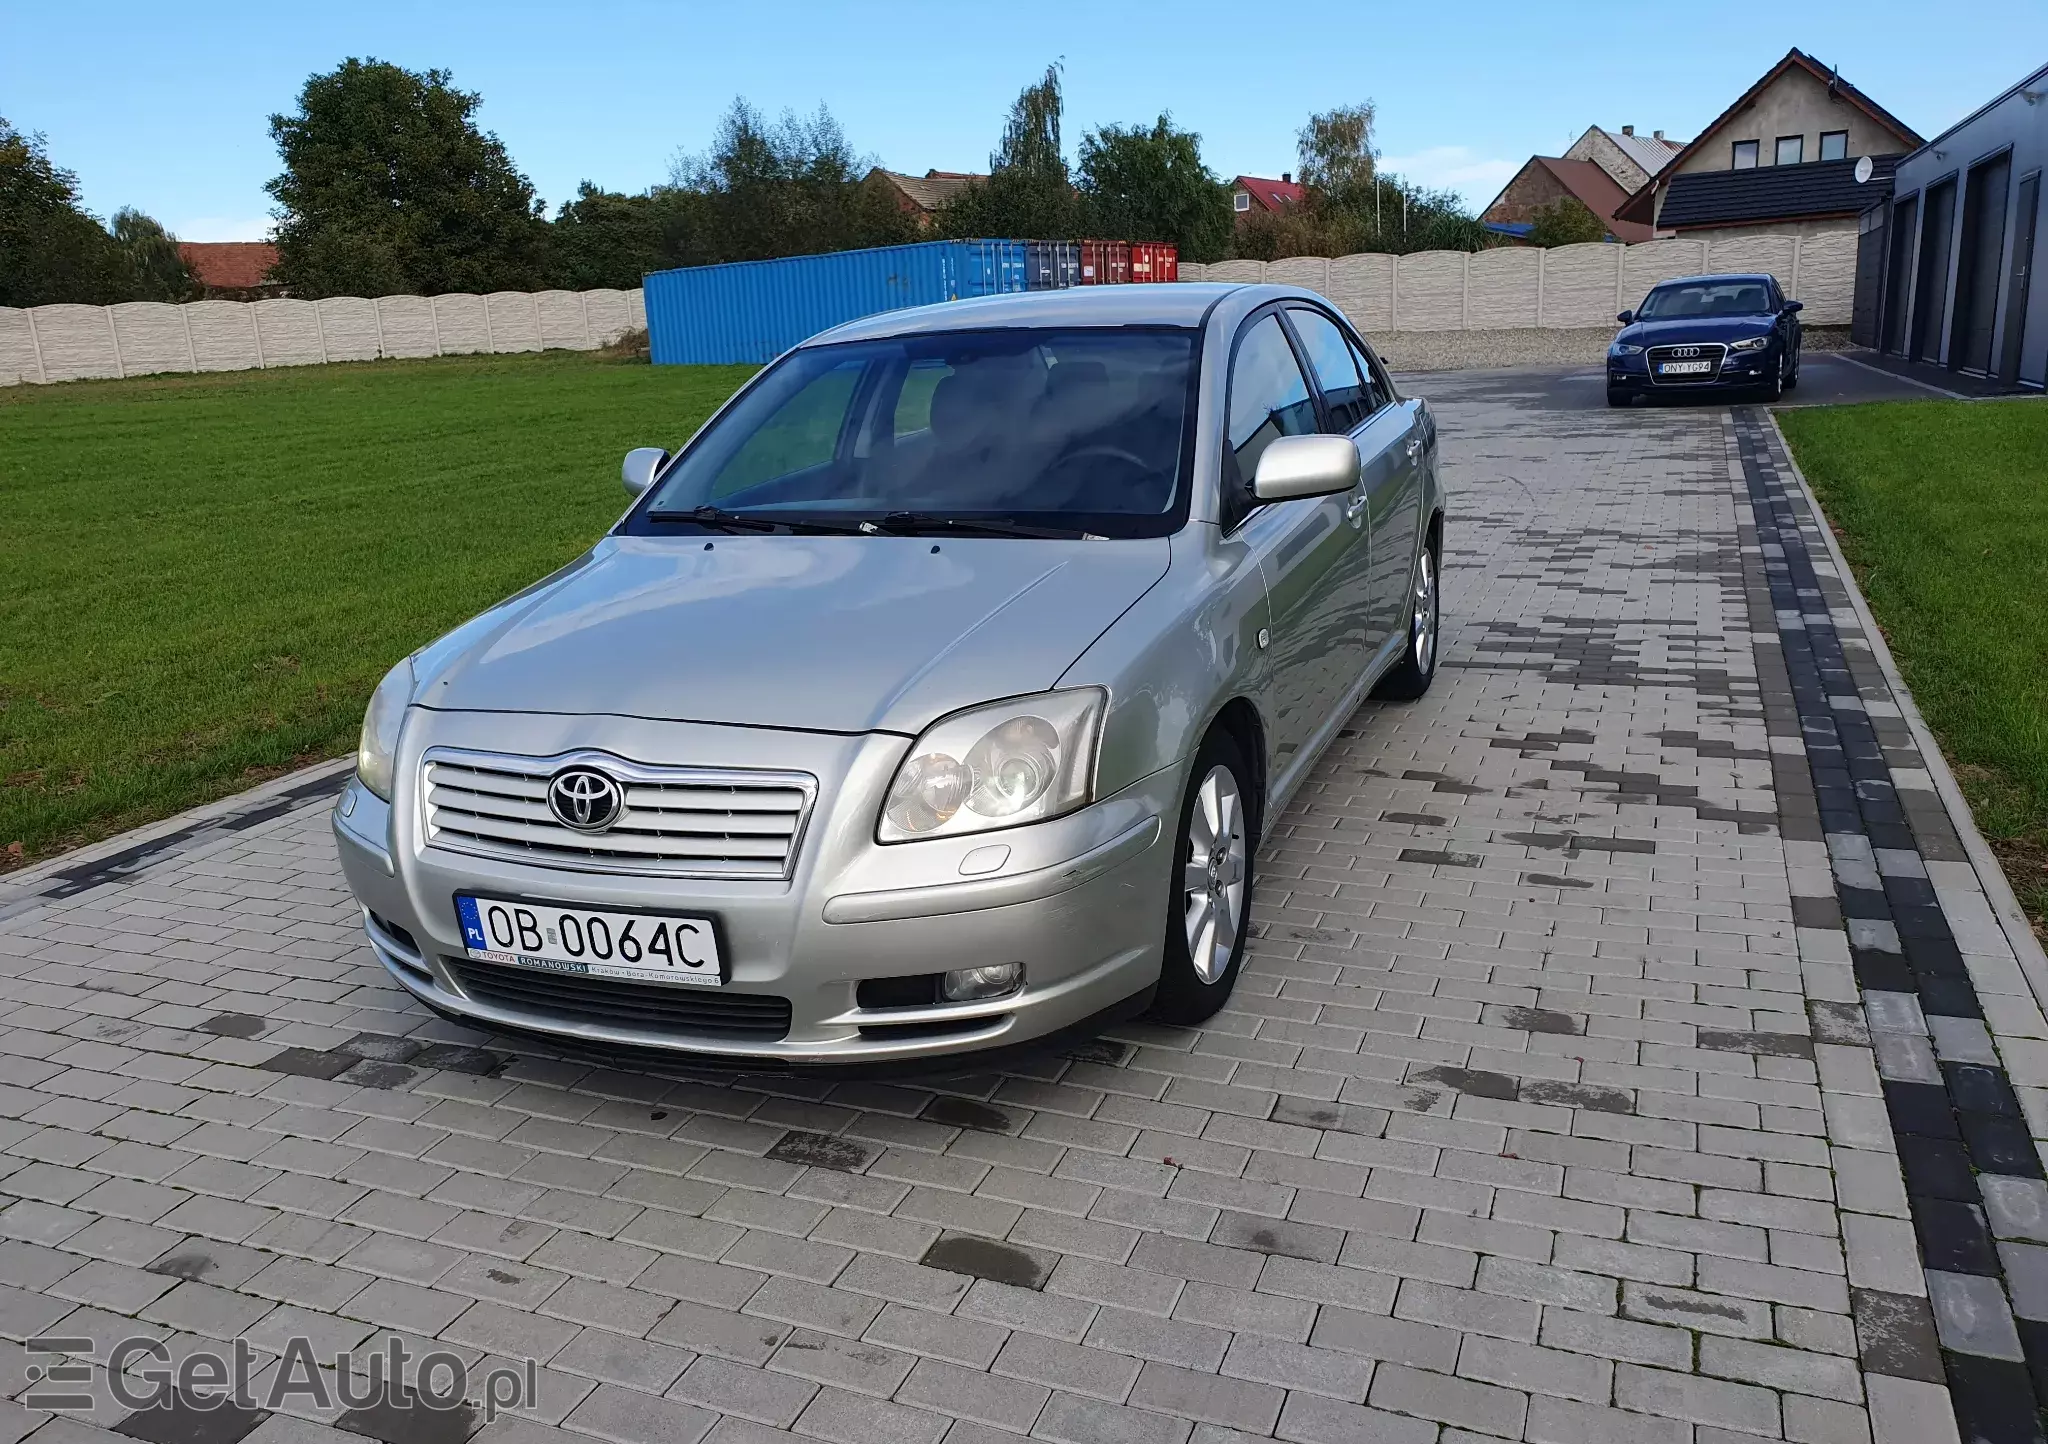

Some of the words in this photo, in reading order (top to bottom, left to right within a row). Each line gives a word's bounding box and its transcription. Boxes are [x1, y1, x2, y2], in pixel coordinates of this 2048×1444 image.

[1664, 364, 1682, 372] ONY
[1687, 363, 1709, 371] YG94
[468, 927, 483, 941] PL
[487, 905, 543, 951] OB
[558, 914, 705, 968] 0064C
[482, 951, 516, 963] TOYOTA
[520, 957, 586, 972] ROMANOWSKI
